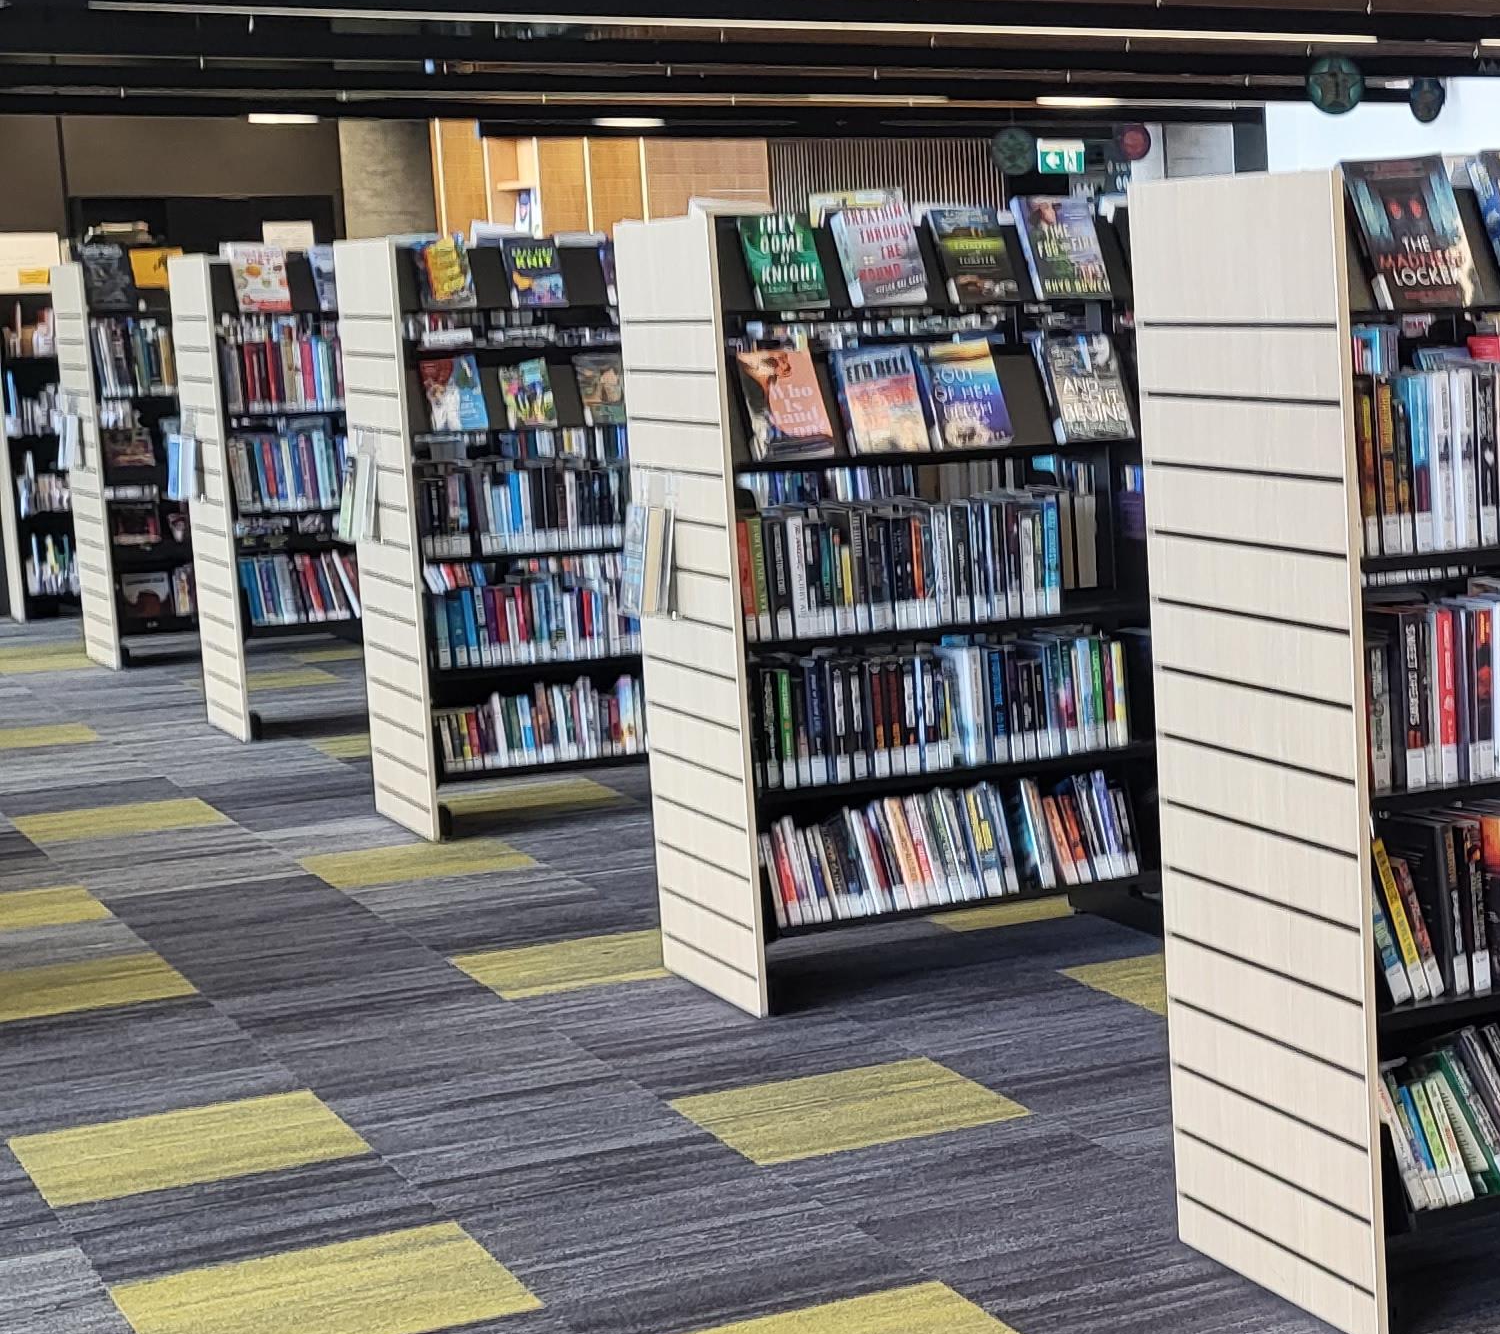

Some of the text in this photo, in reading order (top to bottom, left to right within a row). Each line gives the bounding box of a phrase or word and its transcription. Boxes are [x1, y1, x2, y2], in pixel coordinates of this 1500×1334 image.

[759, 214, 796, 235] THEY
[759, 233, 804, 254] COME
[881, 244, 902, 260] THE
[1401, 234, 1432, 253] THE
[761, 265, 818, 285] KNIGHT
[1392, 266, 1458, 287] LOCKER
[769, 384, 814, 401] Who
[1062, 377, 1098, 396] AND
